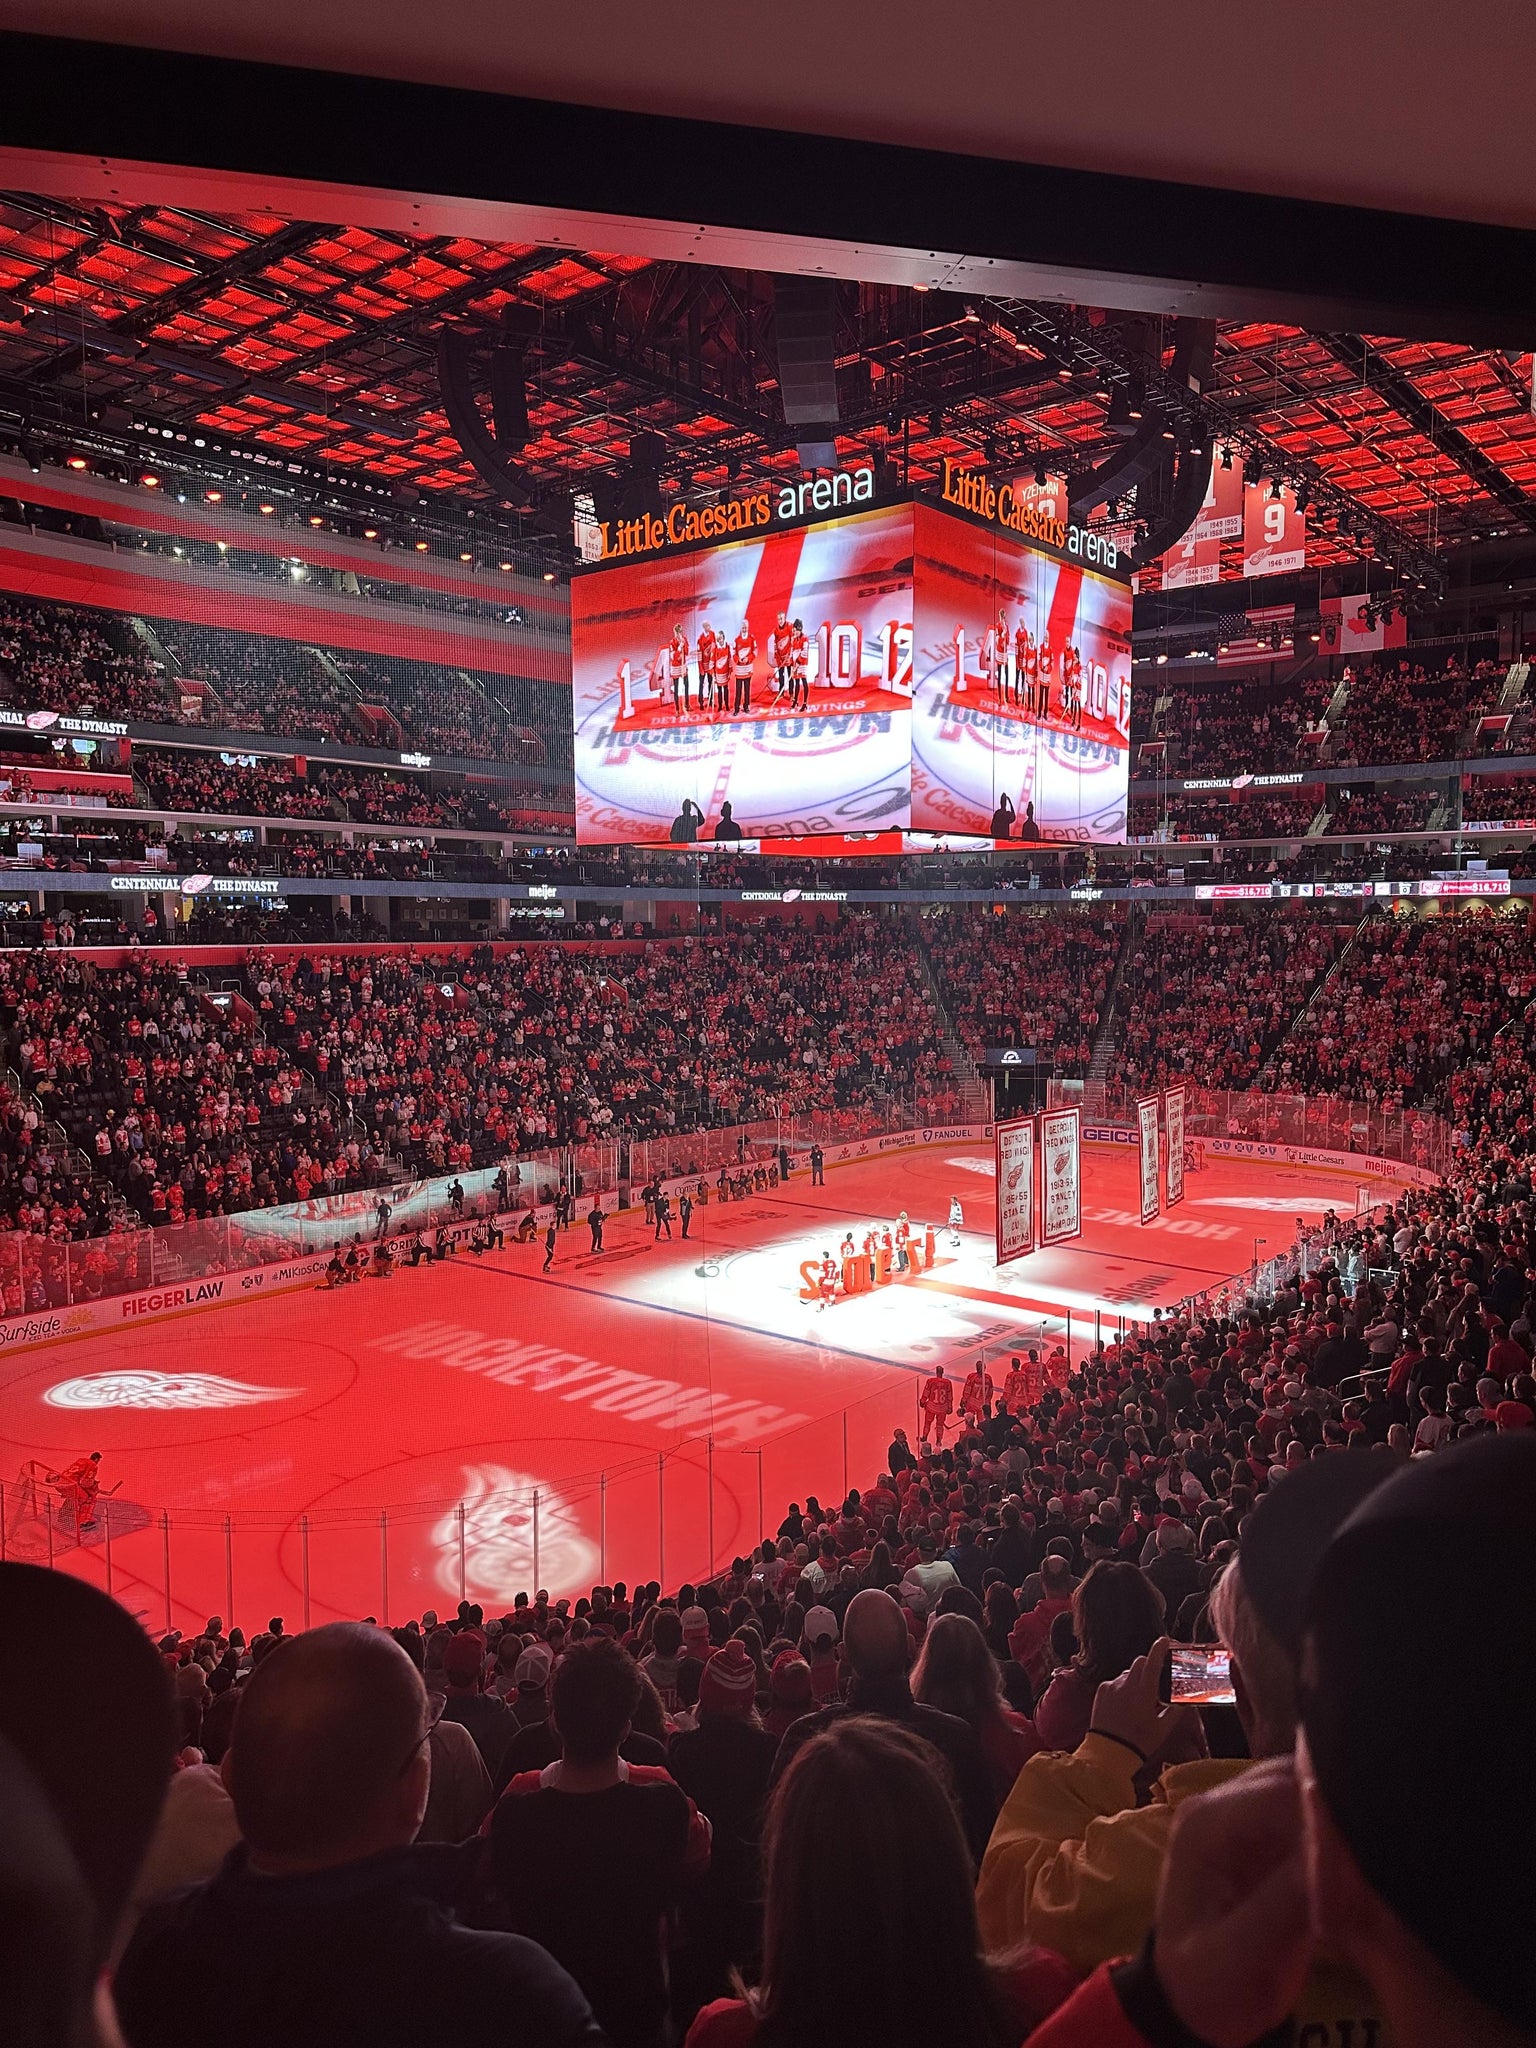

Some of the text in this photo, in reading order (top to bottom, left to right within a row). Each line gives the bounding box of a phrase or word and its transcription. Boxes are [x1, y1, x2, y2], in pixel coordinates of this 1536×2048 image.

[600, 468, 873, 560] Little Caesars arena
[942, 458, 1117, 569] Little Caesars arena
[1264, 504, 1285, 543] 9
[1268, 560, 1281, 568] 1946
[814, 620, 863, 688] 10
[1084, 657, 1109, 720] 10
[59, 718, 82, 731] THE
[82, 720, 128, 735] DYNASTY
[401, 752, 431, 767] meijer
[1184, 774, 1303, 789] CENTENNIAL THE DYNASTY
[741, 814, 836, 837] rena
[111, 878, 279, 893] CENTENNIAL THE DYNASTY
[529, 885, 557, 899] meijer
[801, 892, 815, 900] THE
[815, 892, 848, 901] DYNASTY
[1071, 888, 1103, 901] meijer
[934, 1129, 972, 1139] FANDUEL
[1298, 1151, 1345, 1165] Little Caesars
[1365, 1159, 1396, 1177] meijer
[0, 1316, 61, 1346] Surfside
